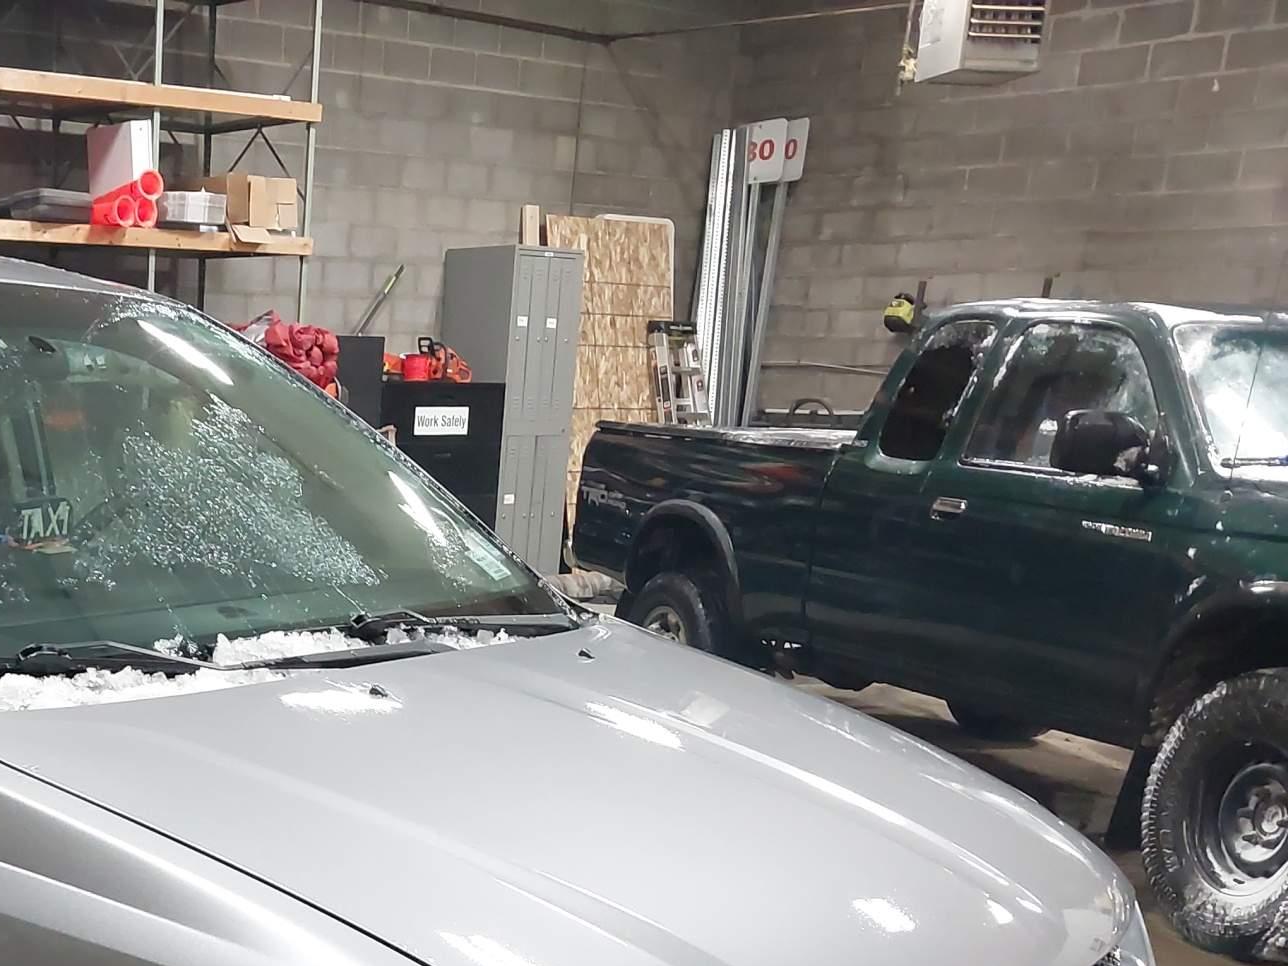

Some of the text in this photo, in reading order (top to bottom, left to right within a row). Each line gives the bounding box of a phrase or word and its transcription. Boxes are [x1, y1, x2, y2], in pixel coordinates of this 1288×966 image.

[417, 414, 466, 430] Work Safely
[20, 500, 70, 540] TAXI
